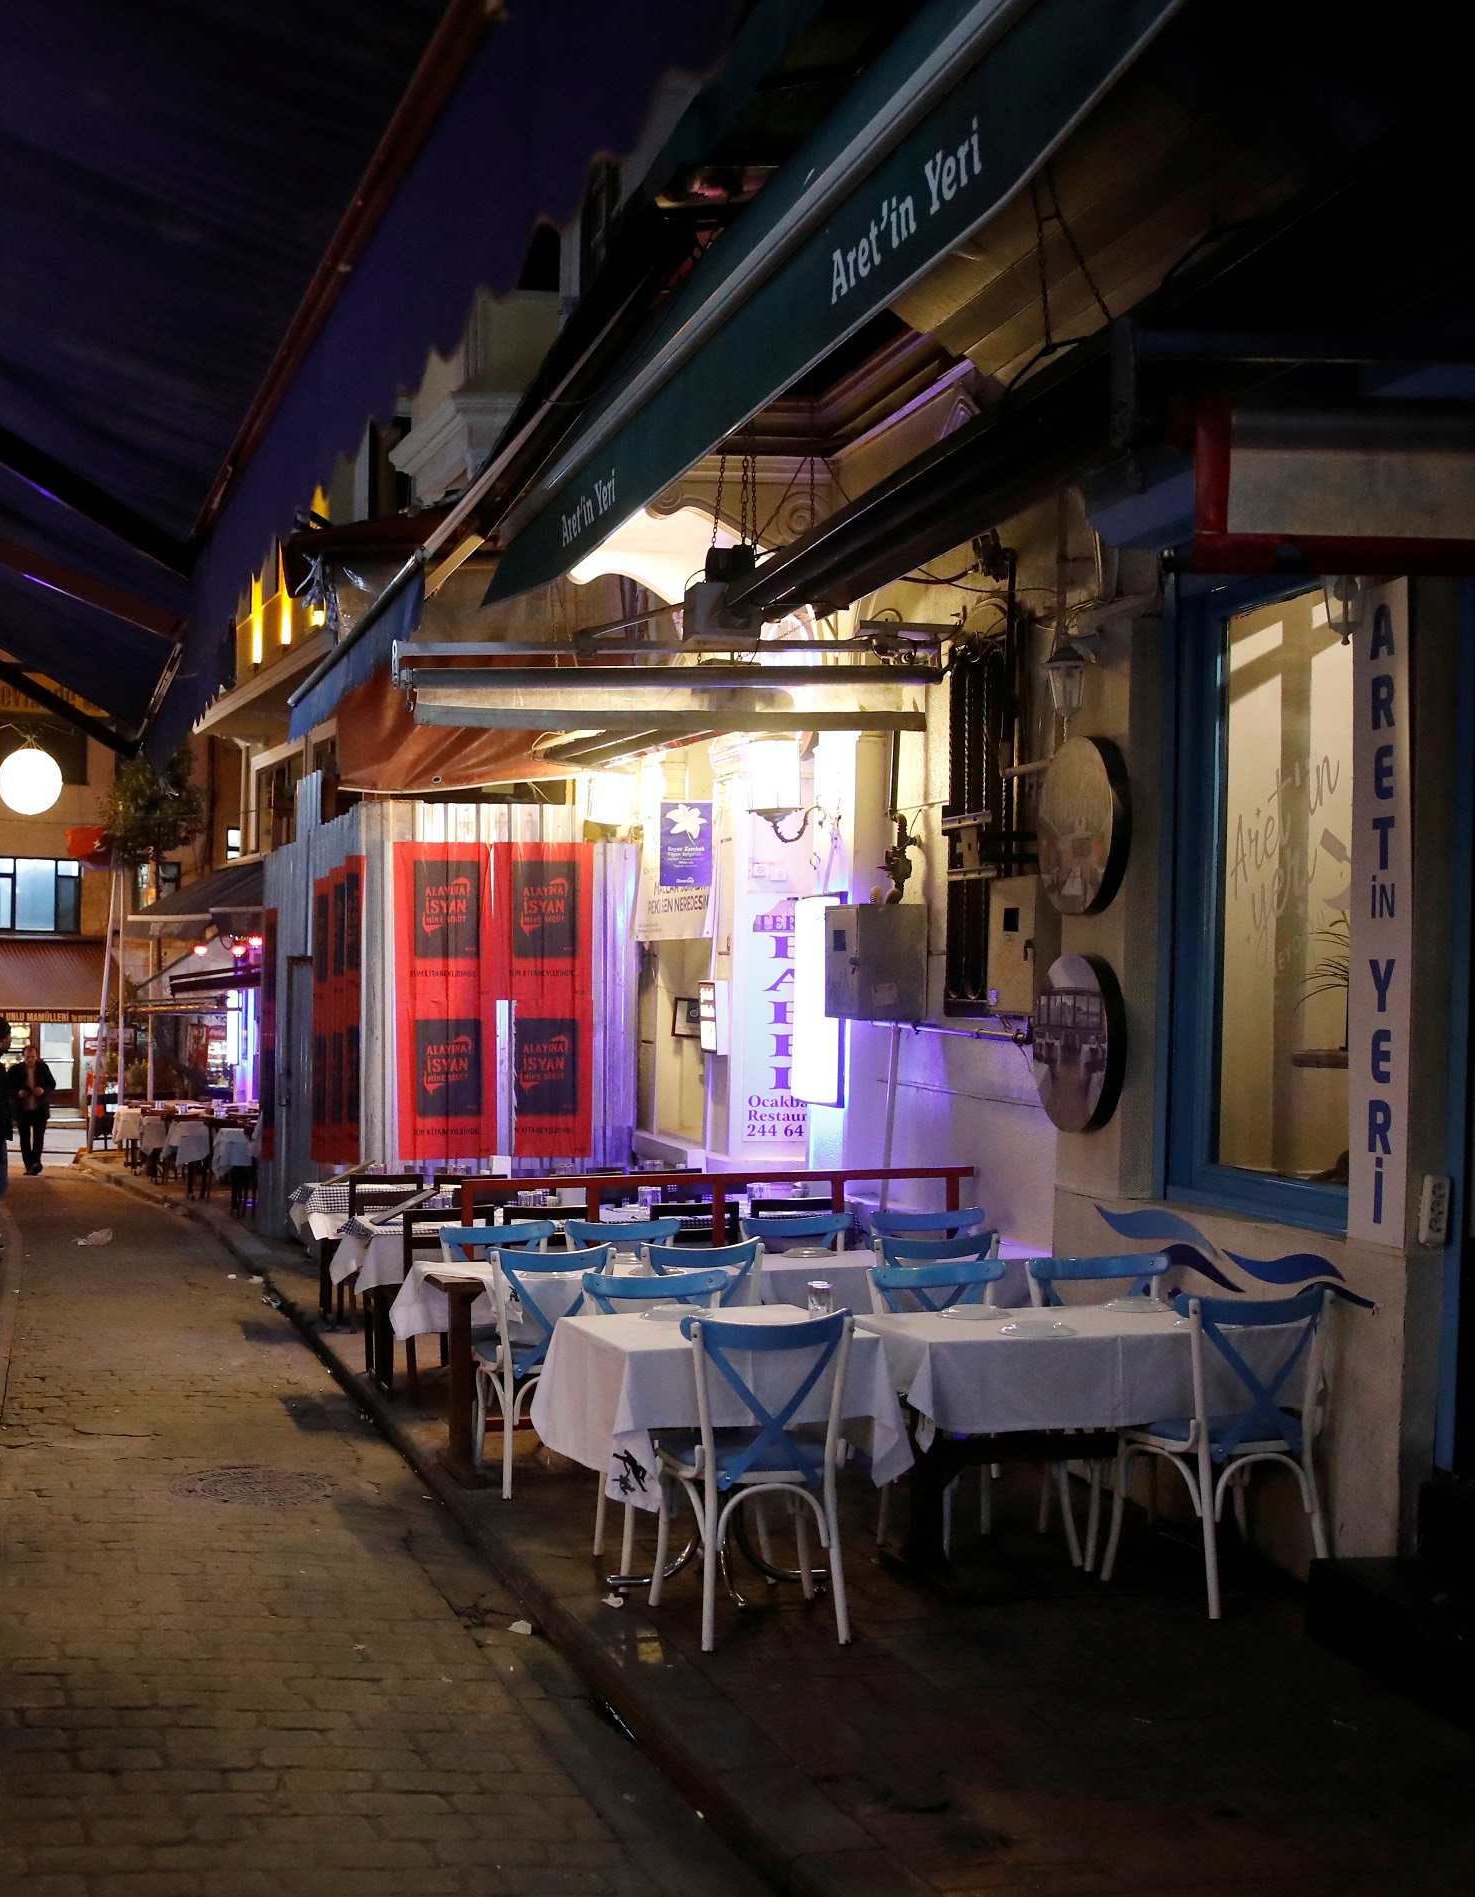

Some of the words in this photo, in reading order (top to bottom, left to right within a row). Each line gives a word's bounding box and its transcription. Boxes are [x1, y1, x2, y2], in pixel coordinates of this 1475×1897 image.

[831, 195, 917, 305] Aret'in
[925, 116, 983, 216] Yeri
[594, 468, 616, 516] Yeri
[425, 897, 468, 914] İSYAN
[523, 897, 566, 914] İSYAN
[6, 1012, 25, 1022] UNLU
[427, 1056, 469, 1073] İSYAN
[747, 1124, 777, 1137] 244
[784, 1124, 804, 1137] 64
